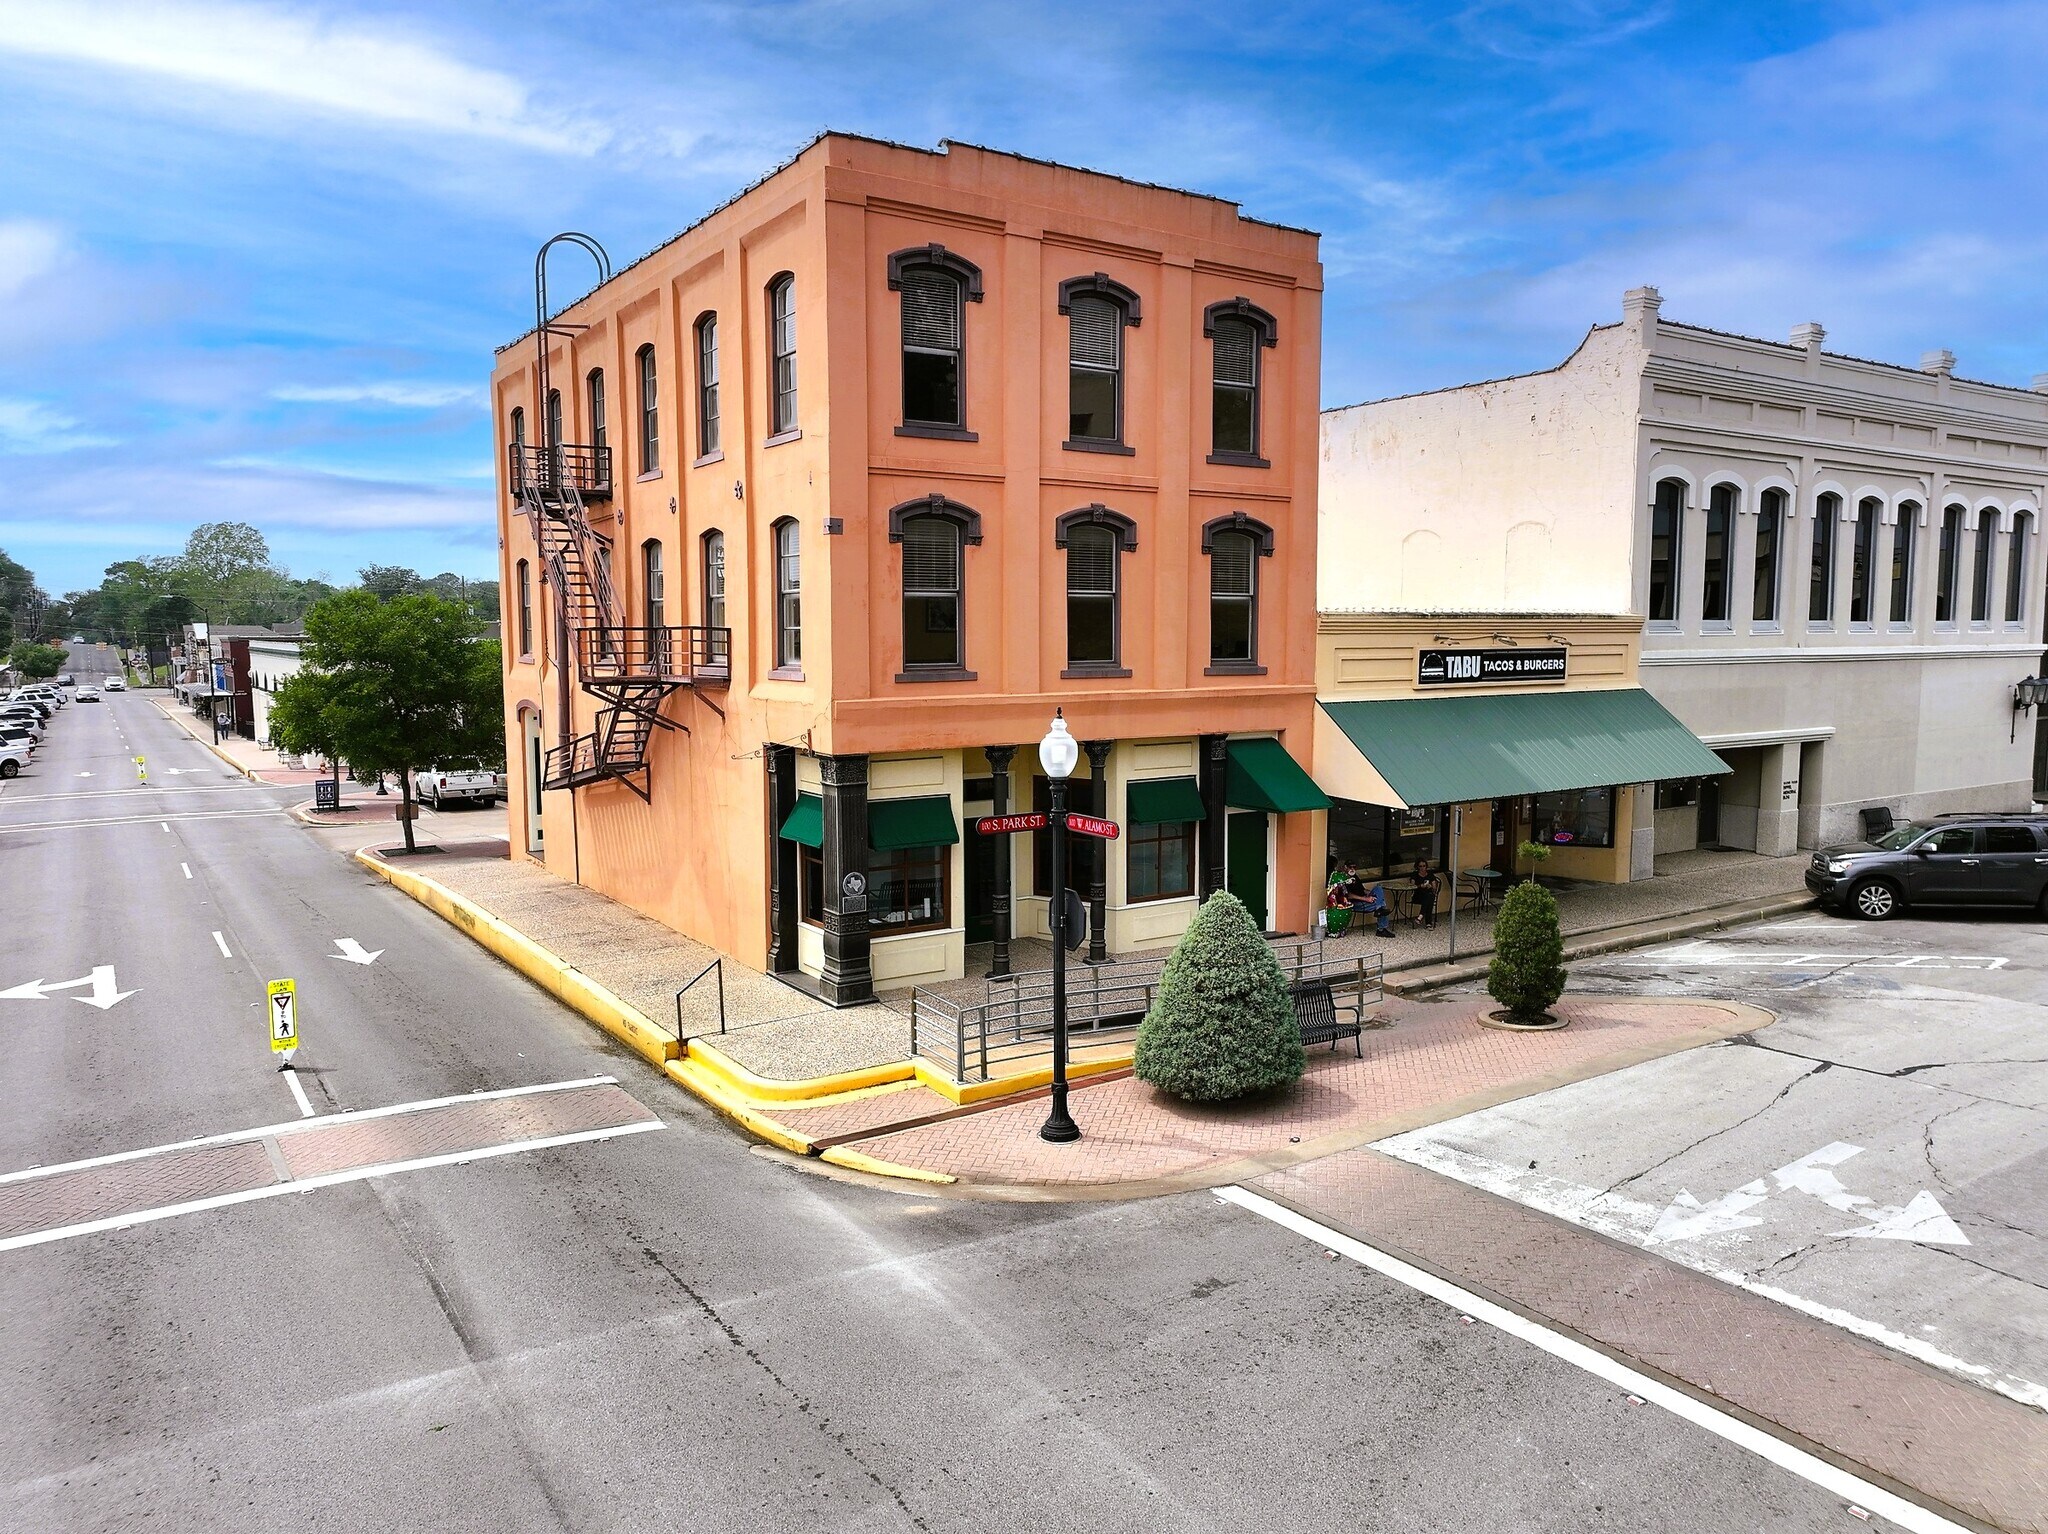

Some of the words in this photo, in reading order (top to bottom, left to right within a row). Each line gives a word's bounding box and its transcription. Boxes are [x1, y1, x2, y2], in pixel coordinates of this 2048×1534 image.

[1446, 655, 1481, 678] TABU
[1484, 660, 1514, 672] TACOS
[1515, 660, 1522, 671] &
[1523, 659, 1564, 671] BURGERS
[992, 819, 1001, 831] S.
[1002, 816, 1028, 830] PARK
[1029, 815, 1044, 827] ST.
[1076, 818, 1085, 829] W.
[1085, 819, 1105, 834] ALAMO
[1105, 823, 1115, 836] ST.
